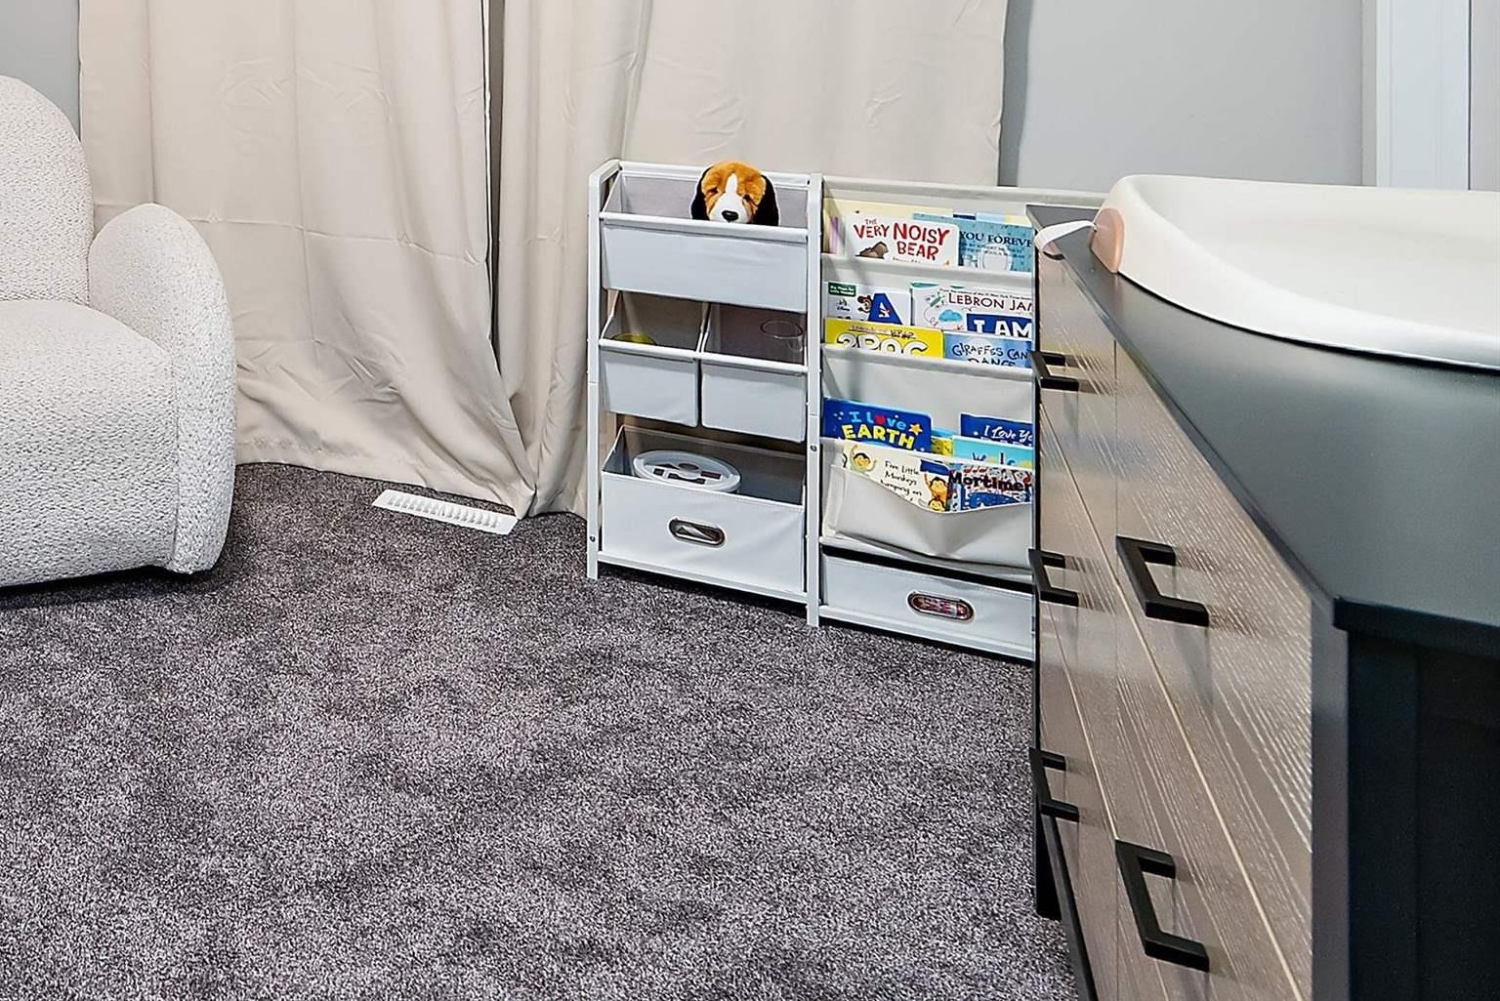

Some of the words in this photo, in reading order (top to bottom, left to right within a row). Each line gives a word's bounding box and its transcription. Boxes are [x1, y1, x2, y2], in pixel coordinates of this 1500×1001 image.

[853, 224, 890, 239] VERY
[893, 222, 950, 246] NOISY
[896, 241, 939, 261] BEAR
[948, 293, 1004, 309] LEBRON
[973, 319, 985, 333] I
[995, 320, 1032, 339] AM
[952, 342, 1004, 357] GIRAFFES
[849, 411, 862, 423] I
[841, 423, 915, 449] EARTH
[984, 424, 991, 436] I
[991, 426, 1017, 439] Love
